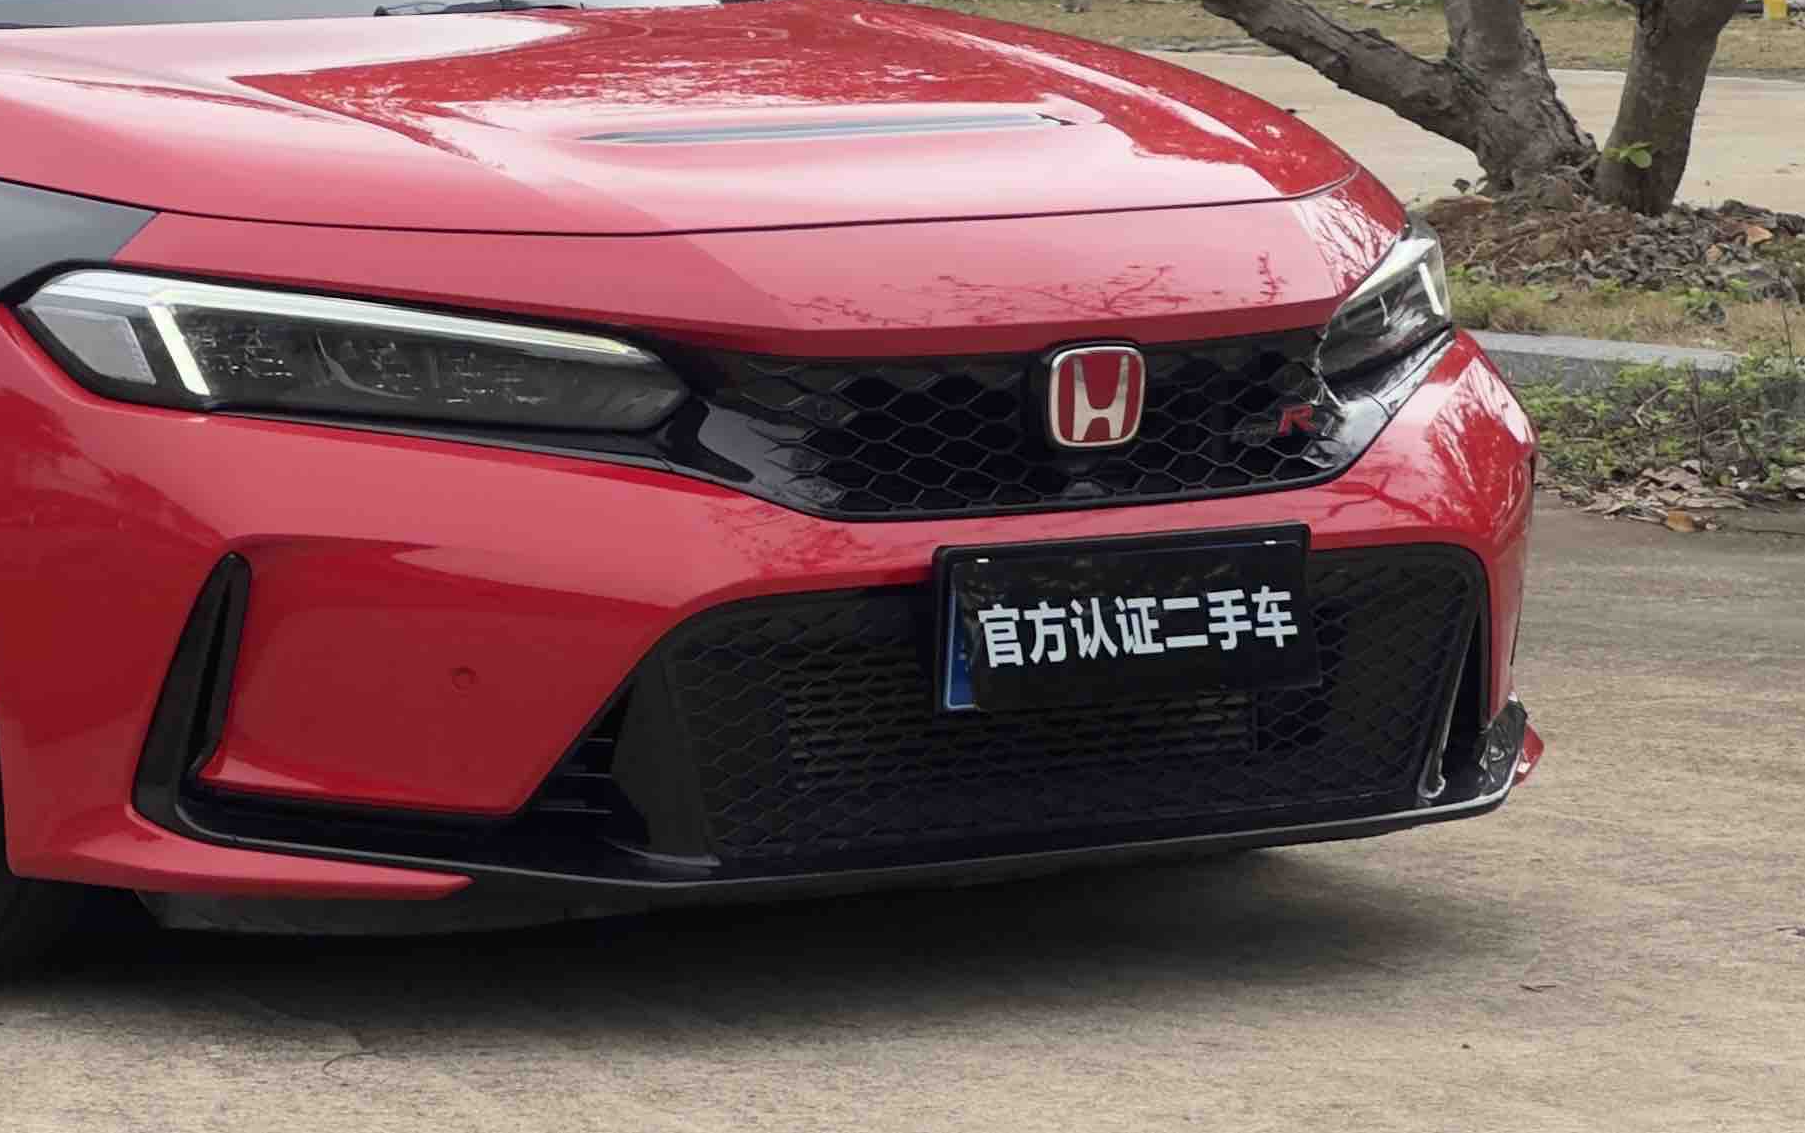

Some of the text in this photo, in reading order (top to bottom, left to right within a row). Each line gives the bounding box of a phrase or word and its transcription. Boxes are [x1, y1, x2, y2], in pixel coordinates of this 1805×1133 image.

[977, 584, 1299, 669] 官方认证二手车
